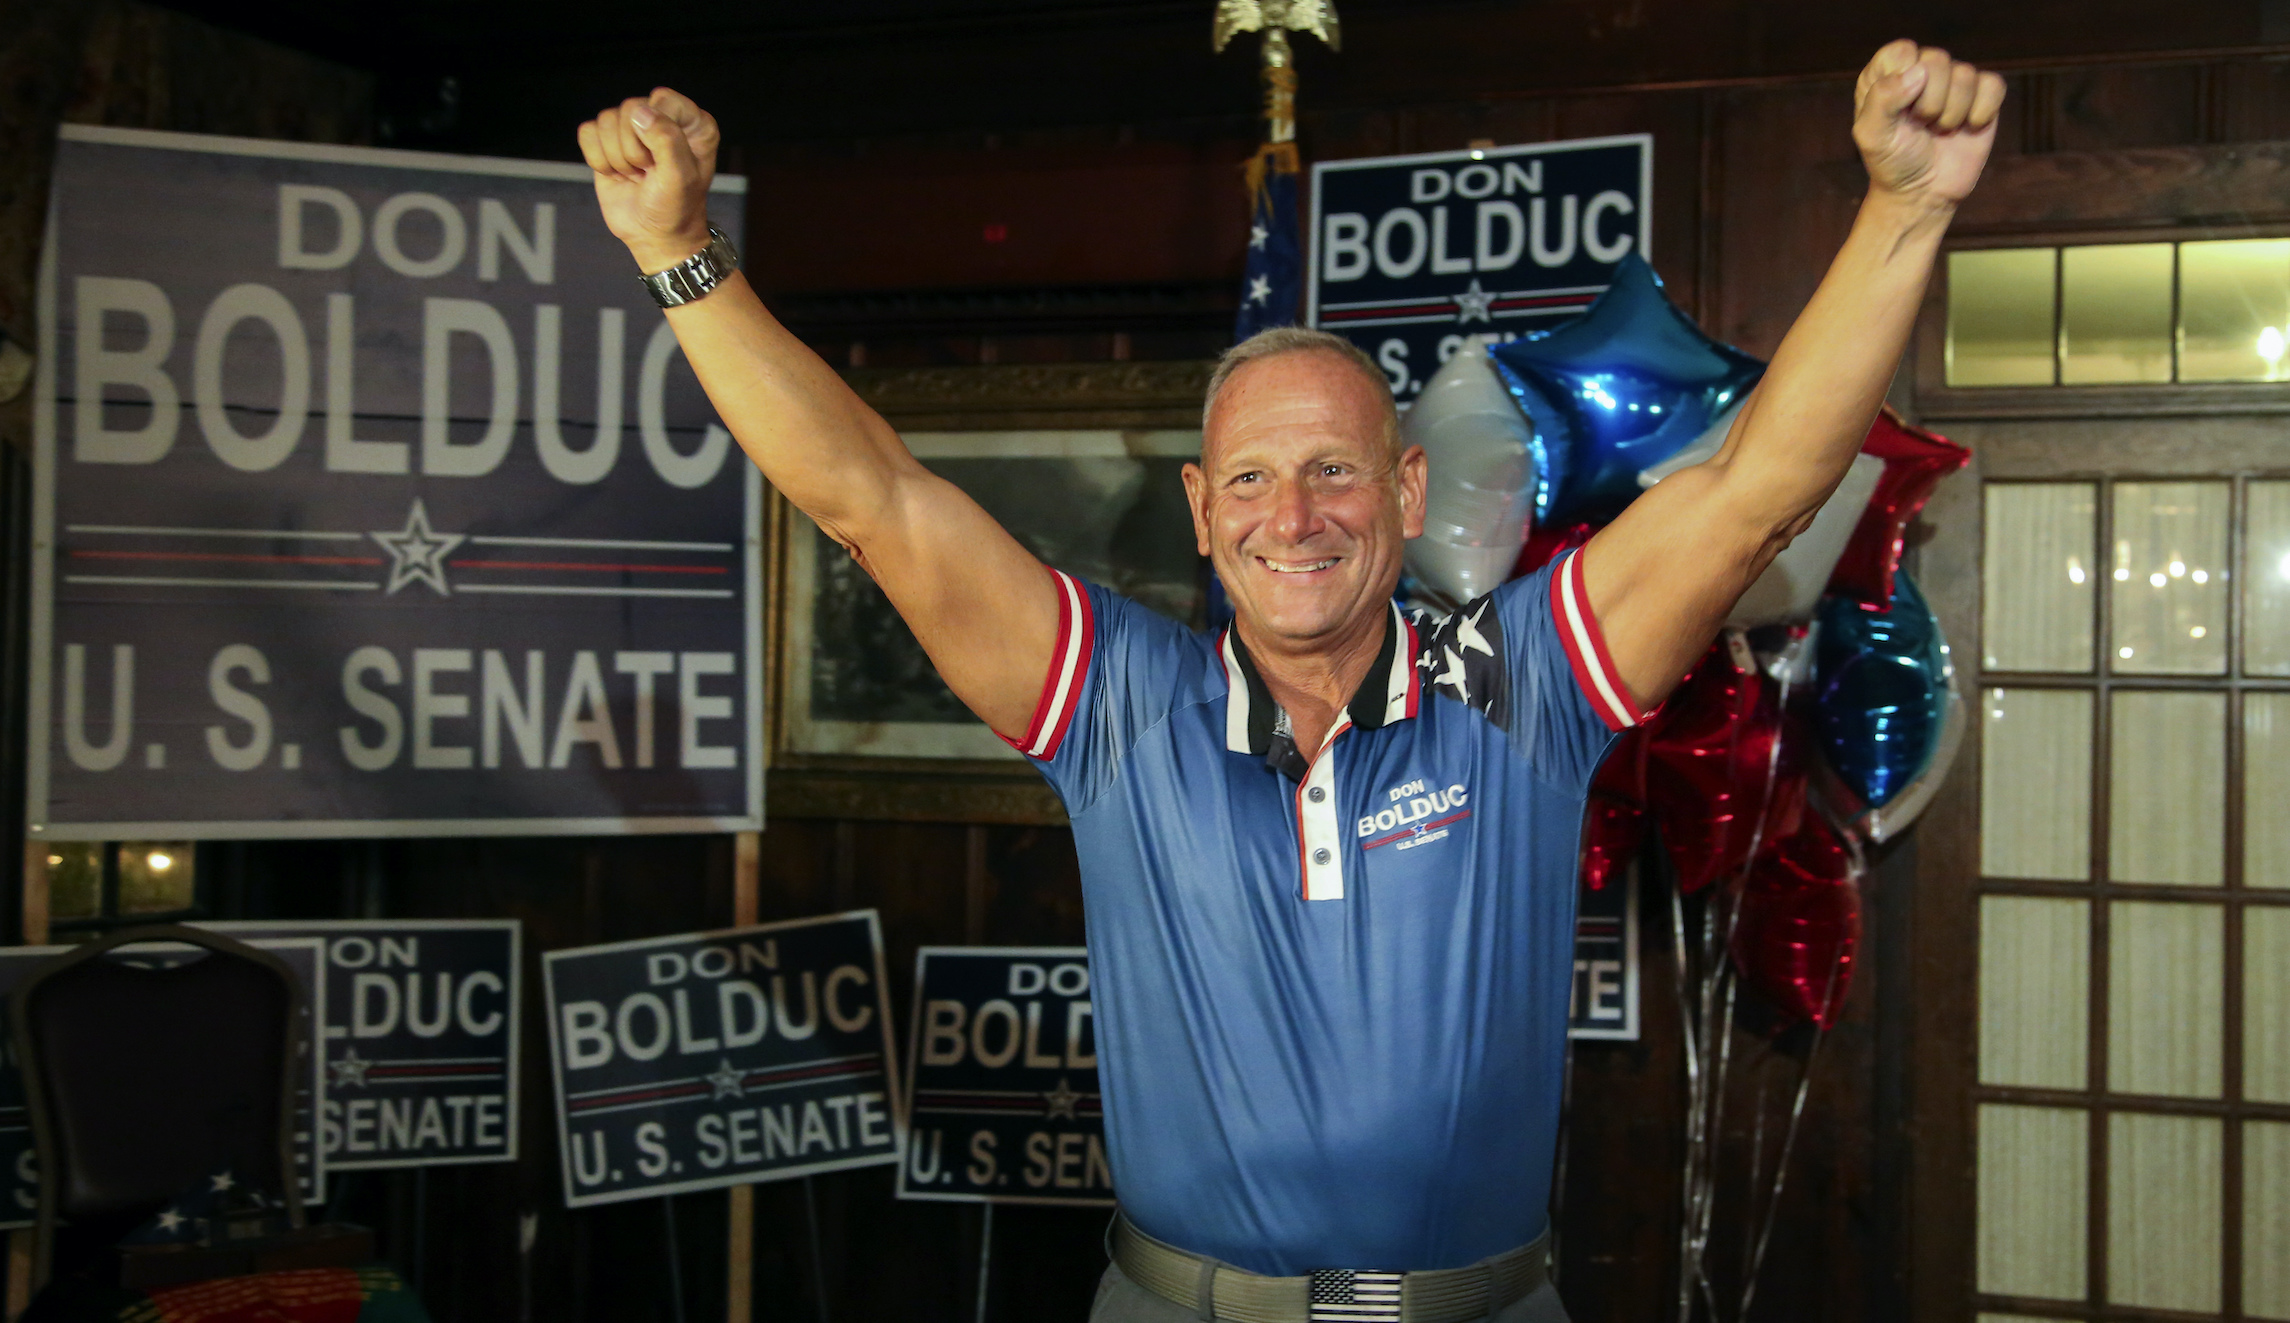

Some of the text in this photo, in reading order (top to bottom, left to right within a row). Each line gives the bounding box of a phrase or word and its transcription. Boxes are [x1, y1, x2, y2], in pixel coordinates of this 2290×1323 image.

[1411, 159, 1543, 203] DON
[277, 183, 557, 285] DON
[1323, 190, 1634, 282] BOLDUC
[73, 275, 732, 489] BOLDUC
[64, 643, 738, 772] U. S. SENATE
[1358, 784, 1468, 837] BOLDUC
[1389, 779, 1425, 801] DON
[647, 939, 780, 986] DON
[562, 964, 873, 1070] BOLDUC
[325, 1095, 504, 1152] SENATE
[572, 1091, 891, 1187] U. S. SENATE
[910, 1129, 953, 1184] U.
[966, 1129, 1009, 1186] S.
